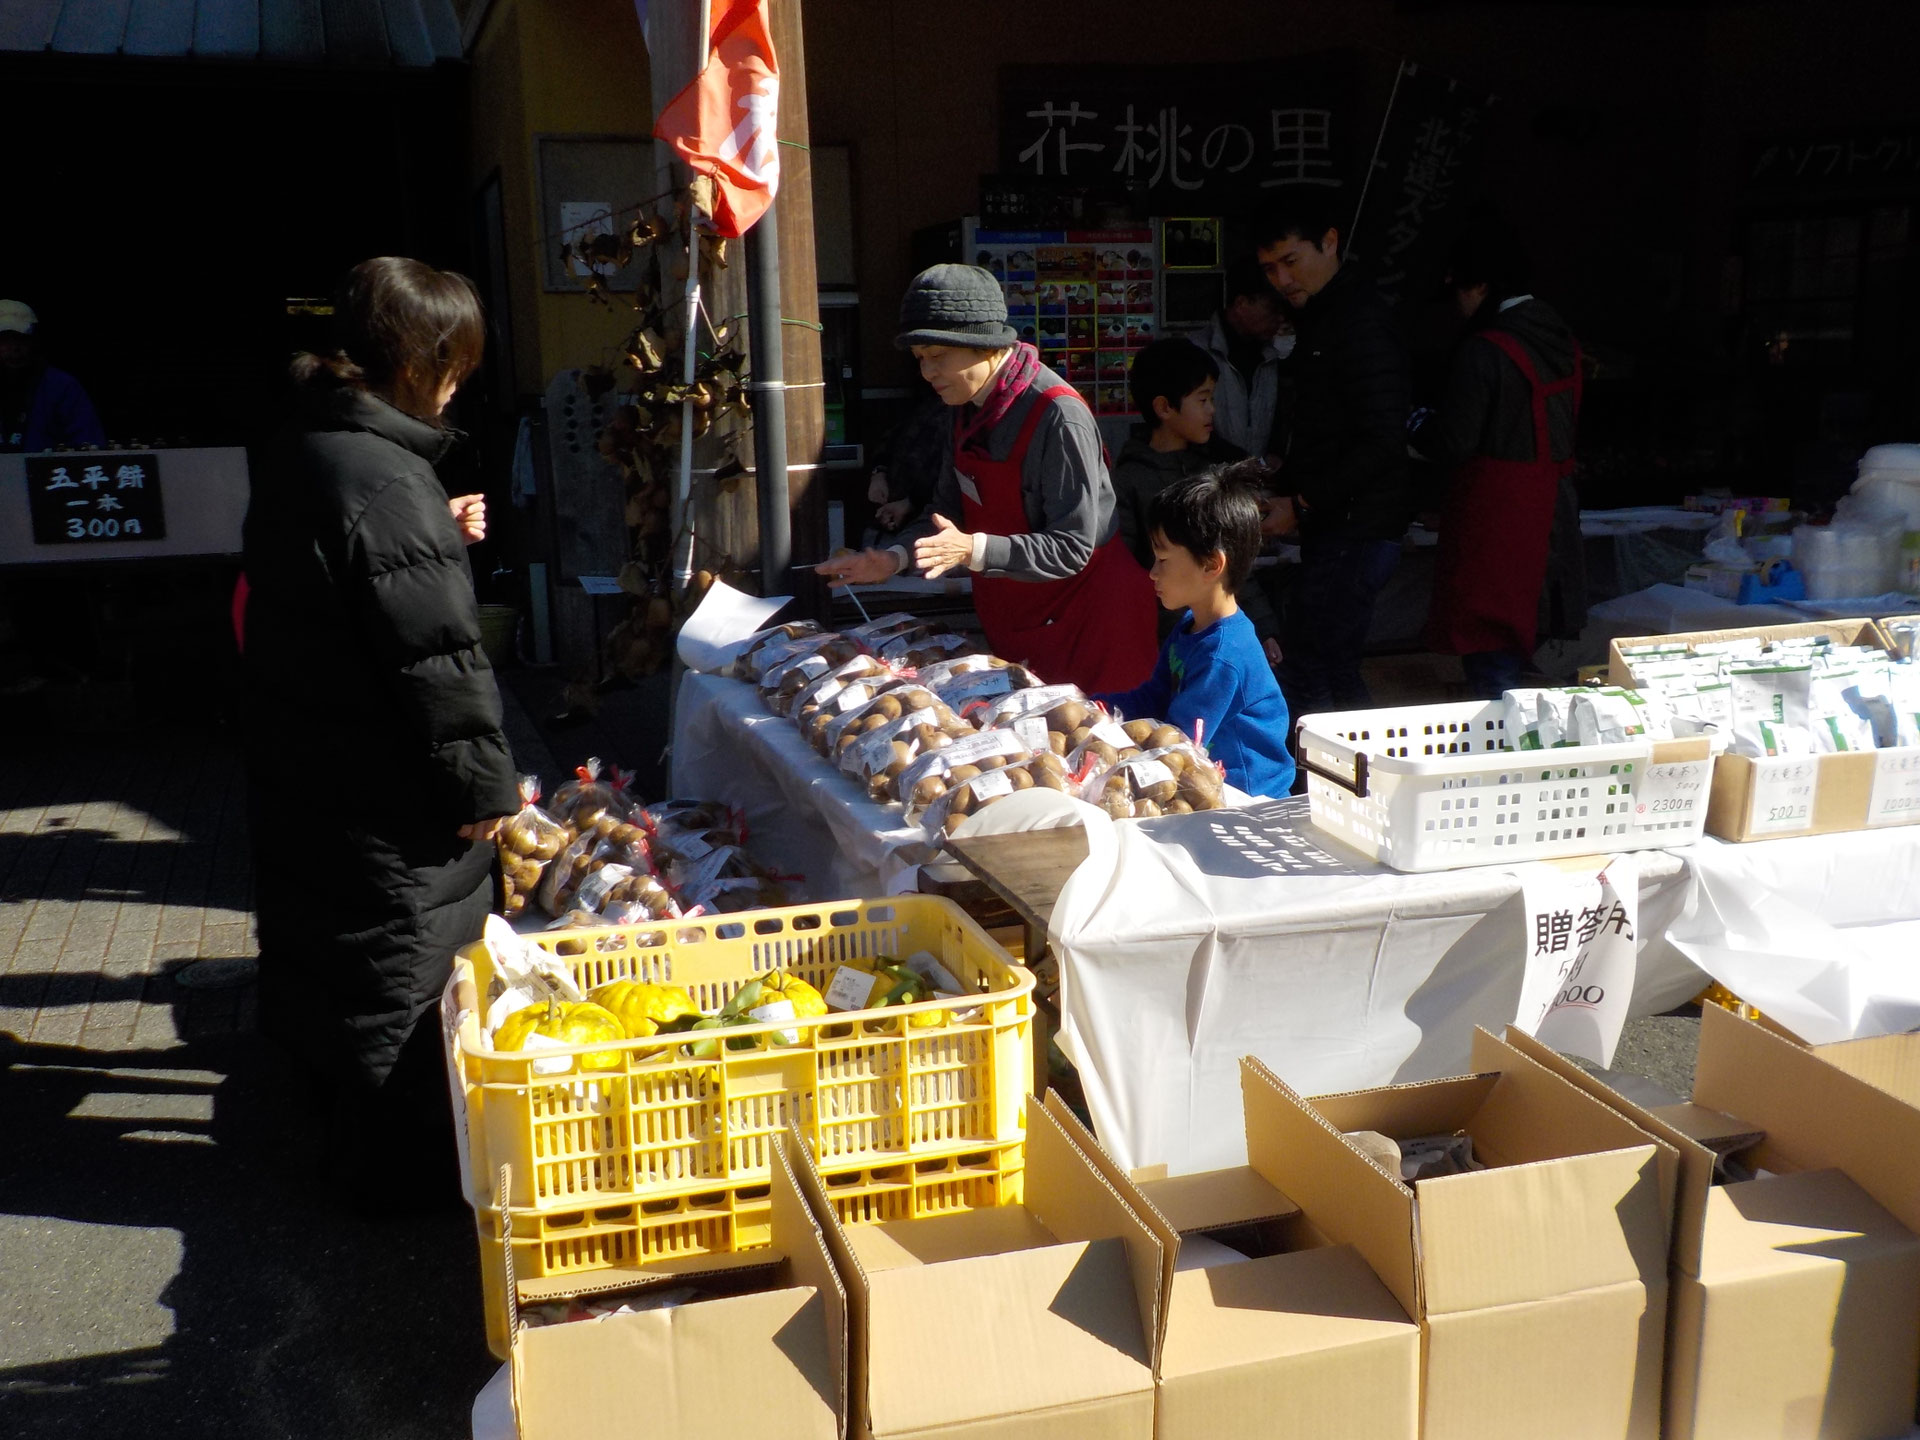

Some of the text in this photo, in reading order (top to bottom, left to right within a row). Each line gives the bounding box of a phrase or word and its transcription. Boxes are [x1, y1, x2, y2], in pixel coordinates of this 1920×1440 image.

[1018, 100, 1344, 192] 花桃の里
[44, 463, 147, 491] 五平餅
[65, 493, 125, 512] 一本
[65, 517, 143, 539] 300円
[1651, 798, 1694, 812] 2300円
